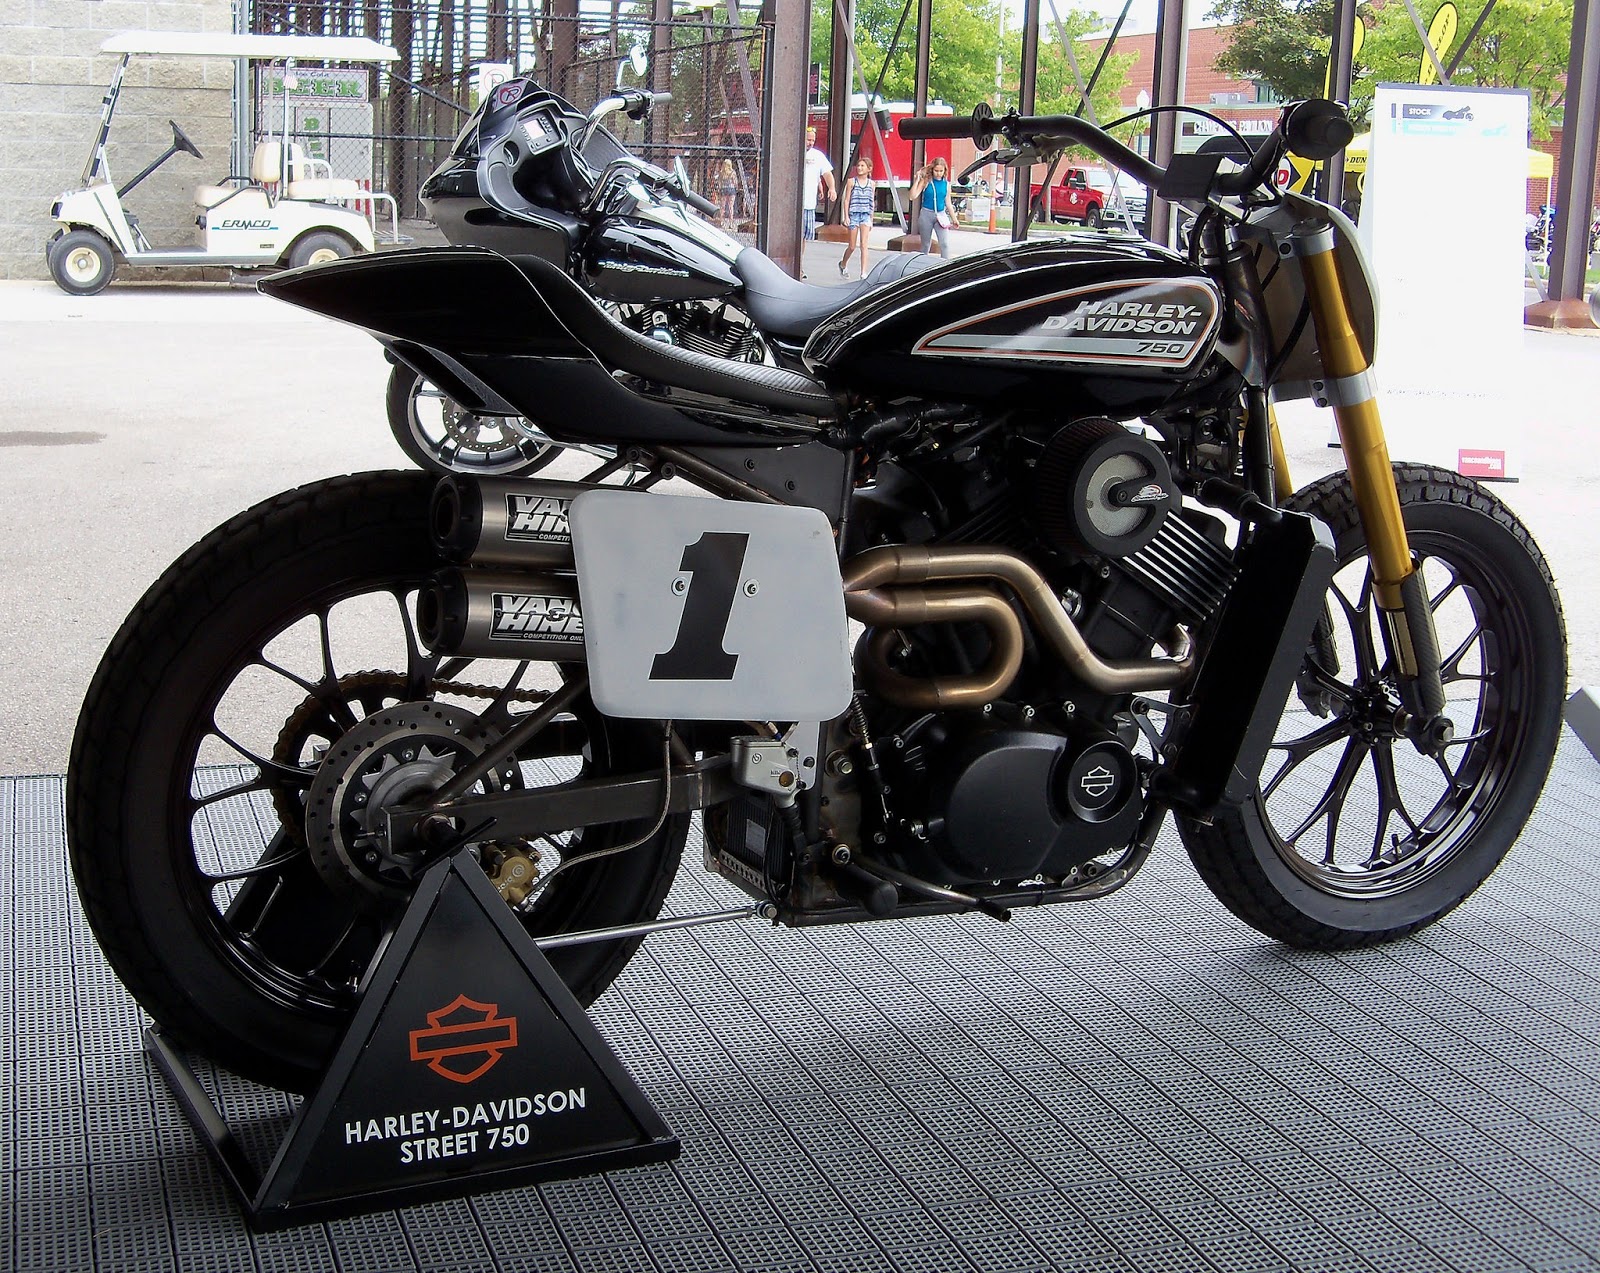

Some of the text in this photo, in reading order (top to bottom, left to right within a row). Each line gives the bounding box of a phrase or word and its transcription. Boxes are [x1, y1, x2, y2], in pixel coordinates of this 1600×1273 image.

[1408, 107, 1431, 117] STOCK
[221, 219, 272, 231] ERMCO
[1074, 300, 1203, 319] HARLEY-
[1040, 315, 1197, 336] DAVIDSON
[1135, 341, 1186, 355] 750
[648, 531, 750, 681] 1
[523, 632, 568, 641] COMPETITION
[345, 1087, 587, 1145] HARLEY-DAVIDSON
[400, 1123, 530, 1164] STREET 750
